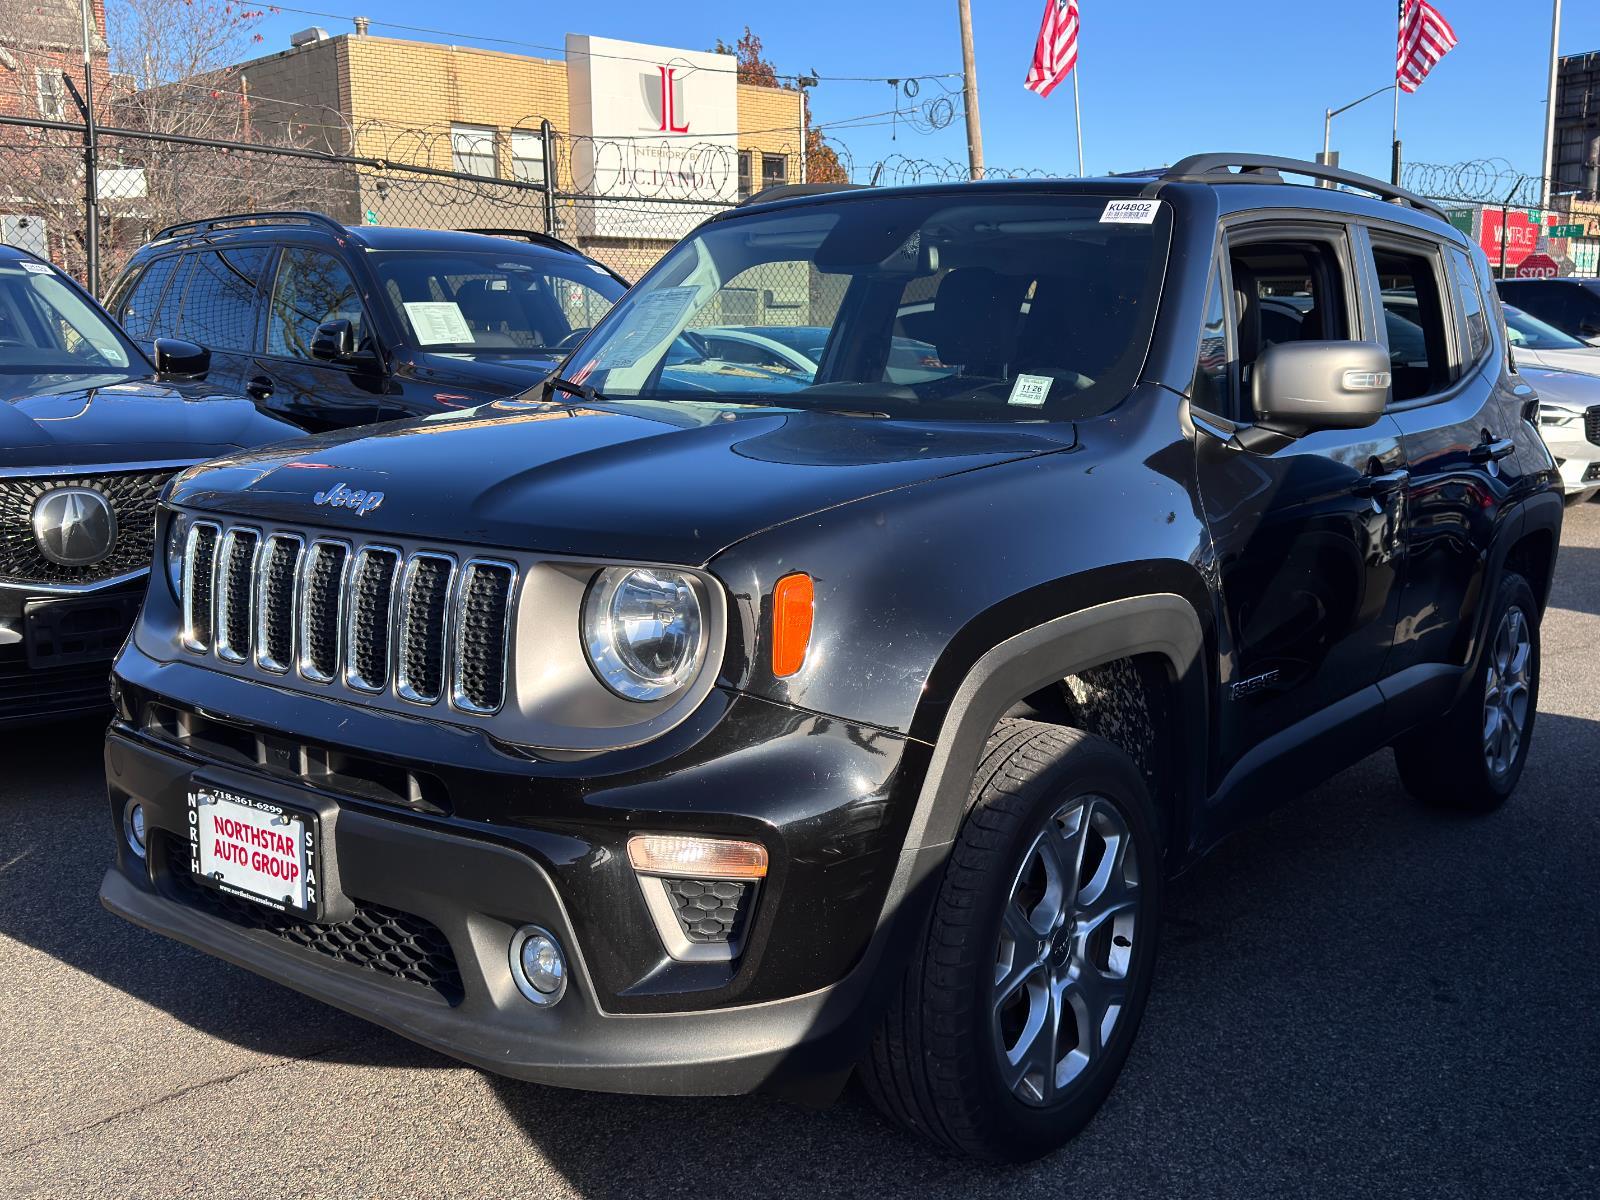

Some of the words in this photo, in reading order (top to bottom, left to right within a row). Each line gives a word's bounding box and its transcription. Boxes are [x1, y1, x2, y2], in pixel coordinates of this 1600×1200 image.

[1108, 203, 1152, 212] KU4802
[1556, 226, 1567, 237] 47
[1519, 267, 1556, 279] STOP
[313, 482, 385, 517] Jeep
[213, 789, 283, 815] 718-361-6299
[187, 792, 200, 874] NORTH
[213, 815, 296, 858] NORTHSTAR
[213, 838, 248, 867] AUTO
[251, 851, 299, 883] GROUP
[305, 831, 317, 904] STAR
